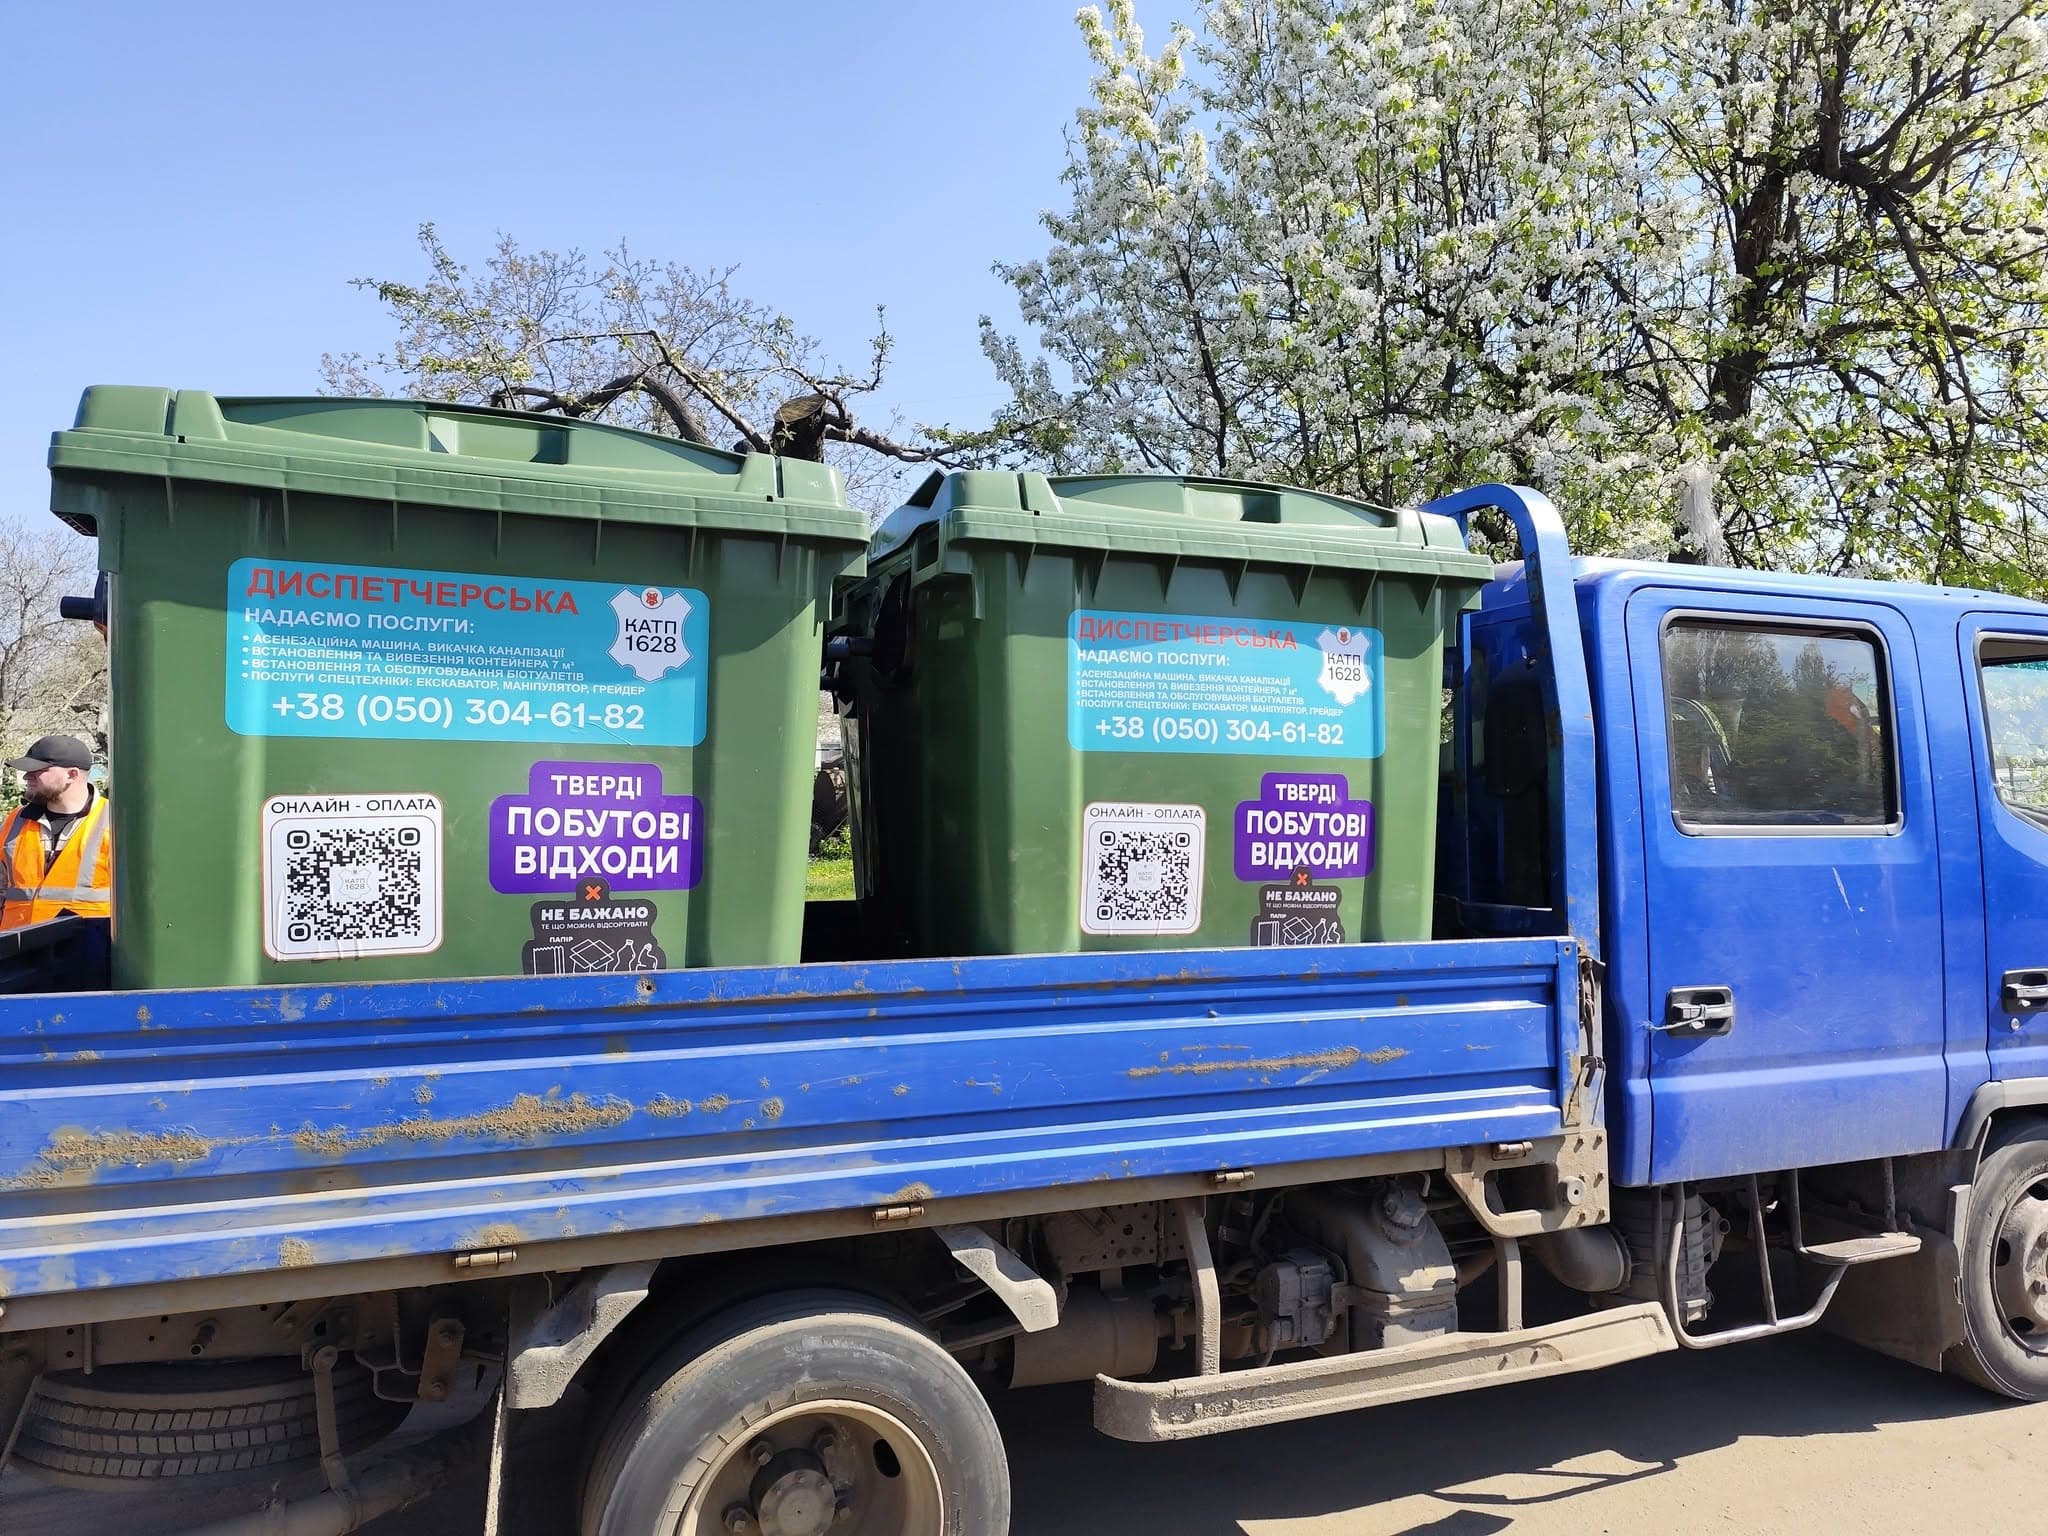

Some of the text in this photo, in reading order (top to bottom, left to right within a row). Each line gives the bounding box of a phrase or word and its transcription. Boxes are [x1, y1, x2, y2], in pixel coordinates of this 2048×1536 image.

[247, 567, 579, 616] ДИСПЕТЧЕРСЬКА
[245, 608, 475, 636] НАДАЄМО ПОСЛУГИ:
[625, 618, 677, 636] КАТП
[625, 635, 677, 653] 1628
[1078, 617, 1297, 650] ДИСПЕТЧЕРСЬКА
[253, 634, 565, 659] АСЕНЕЗАЦІЙНА МАШИНА. ВИКАЧКА КАНАЛІЗАЦІЇ
[252, 646, 362, 660] ВСТАНОВЛЕННЯ
[366, 651, 383, 661] ТА
[386, 652, 464, 665] ВИВЕЗЕННЯ
[468, 656, 549, 669] КОНТЕЙНЕРА
[552, 660, 558, 669] 7
[1077, 650, 1230, 667] НАДАЄМО ПОСЛУГИ:
[1327, 652, 1361, 665] КАТП
[252, 658, 584, 682] ВСТАНОВЛЕННЯ ТА ОБСЛУГОВУВАННЯ БІОТУАЛЕТІВ
[1329, 667, 1361, 682] 1628
[251, 671, 645, 696] ПОСЛУГИ СПЕЦТЕХНІКИ: ЕКСКАВАТОР, МАНІПУЛЯТОР, ГРЕЙДЕР
[1081, 680, 1155, 689] ВСТАНОВЛЕННЯ
[1081, 690, 1155, 699] ВСТАНОВЛЕННЯ
[1157, 692, 1168, 700] ТА
[1081, 699, 1123, 708] ПОСЛУГИ
[273, 692, 645, 730] +38 (050) 304-61-82
[1096, 717, 1344, 745] +38 (050) 304-61-82
[551, 774, 642, 799] ТВЕРДІ
[1275, 784, 1336, 804] ТВЕРДІ
[271, 798, 350, 814] ОНЛАЙН
[367, 798, 436, 812] ОПЛАТА
[1090, 806, 1143, 818] ОНЛАЙН
[1154, 808, 1202, 819] ОПЛАТА
[507, 805, 691, 841] ПОБУТОВІ
[1246, 810, 1366, 837] ПОБУТОВІ
[515, 846, 679, 880] ВІДХОДИ
[1251, 841, 1358, 870] ВІДХОДИ
[1266, 891, 1337, 902] НЕ БАЖАНО
[541, 906, 648, 920] НЕ БАЖАНО
[597, 921, 648, 929] ВІДСОРТУВАТИ
